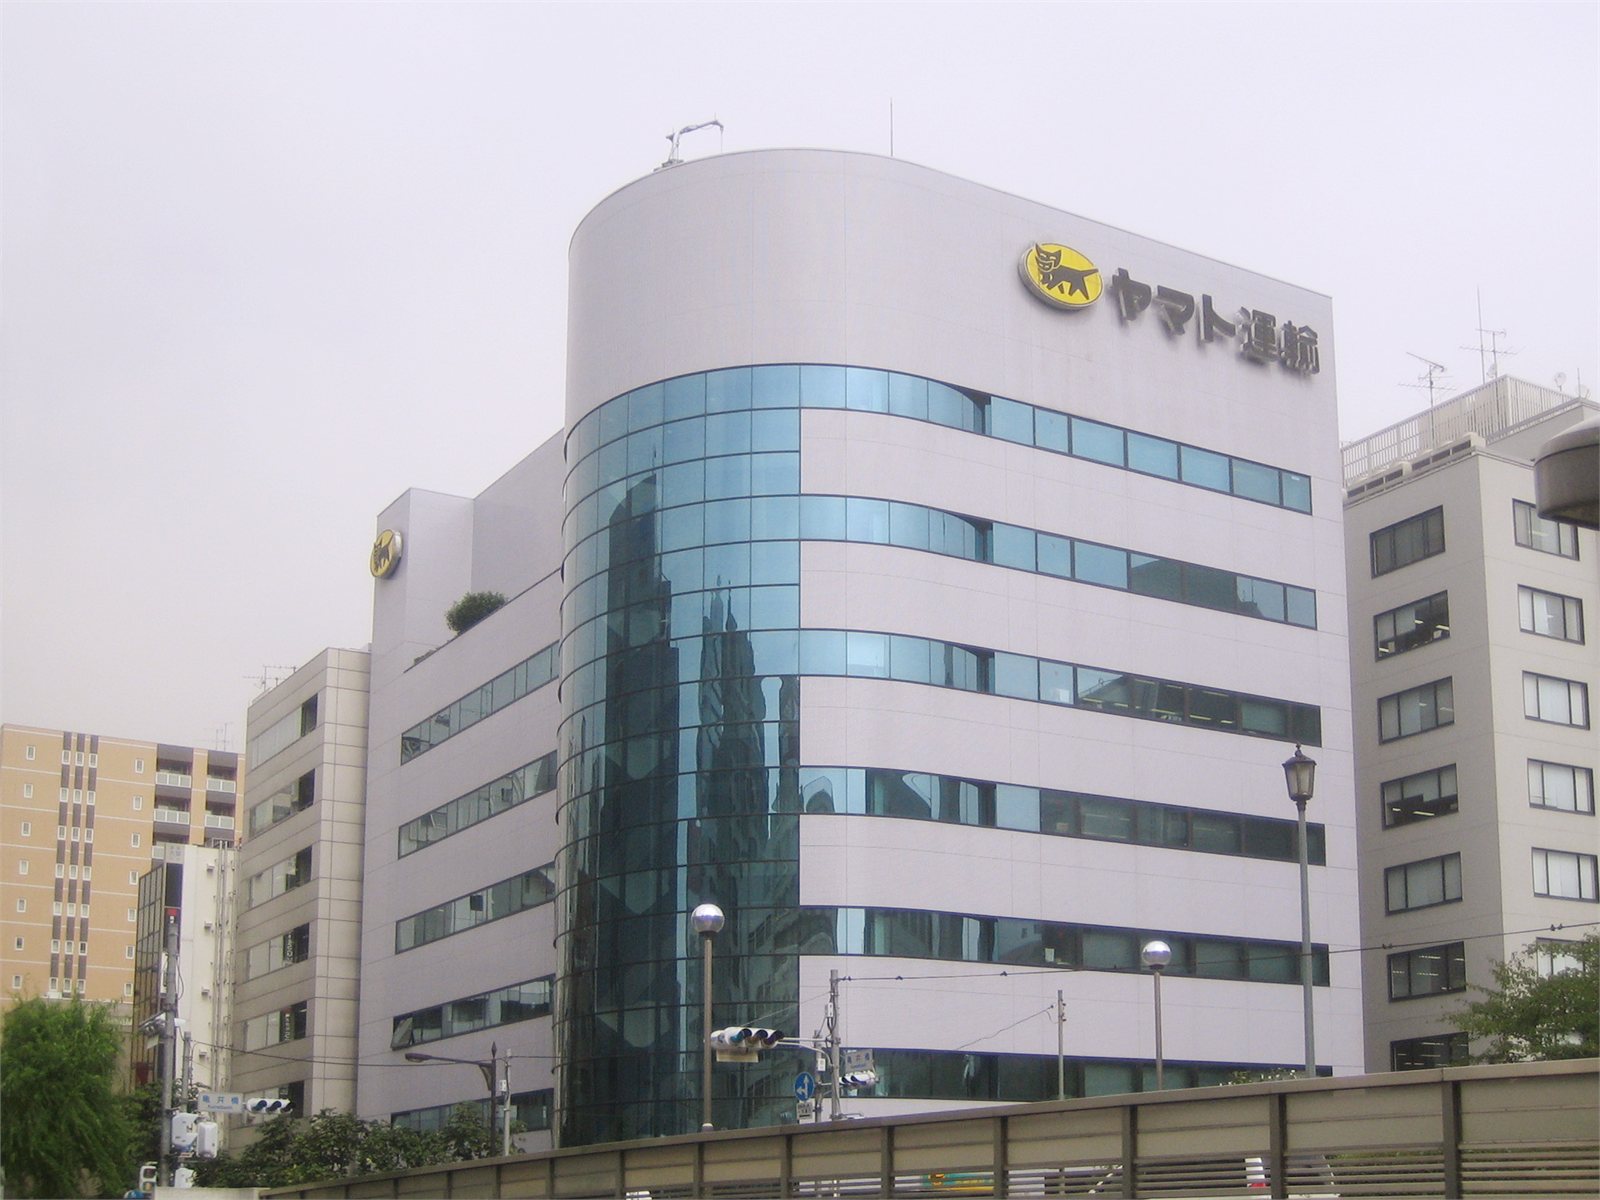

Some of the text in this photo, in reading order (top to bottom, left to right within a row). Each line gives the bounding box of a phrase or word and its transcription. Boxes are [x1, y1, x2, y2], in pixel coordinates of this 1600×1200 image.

[1111, 267, 1320, 375] ヤマト運輸
